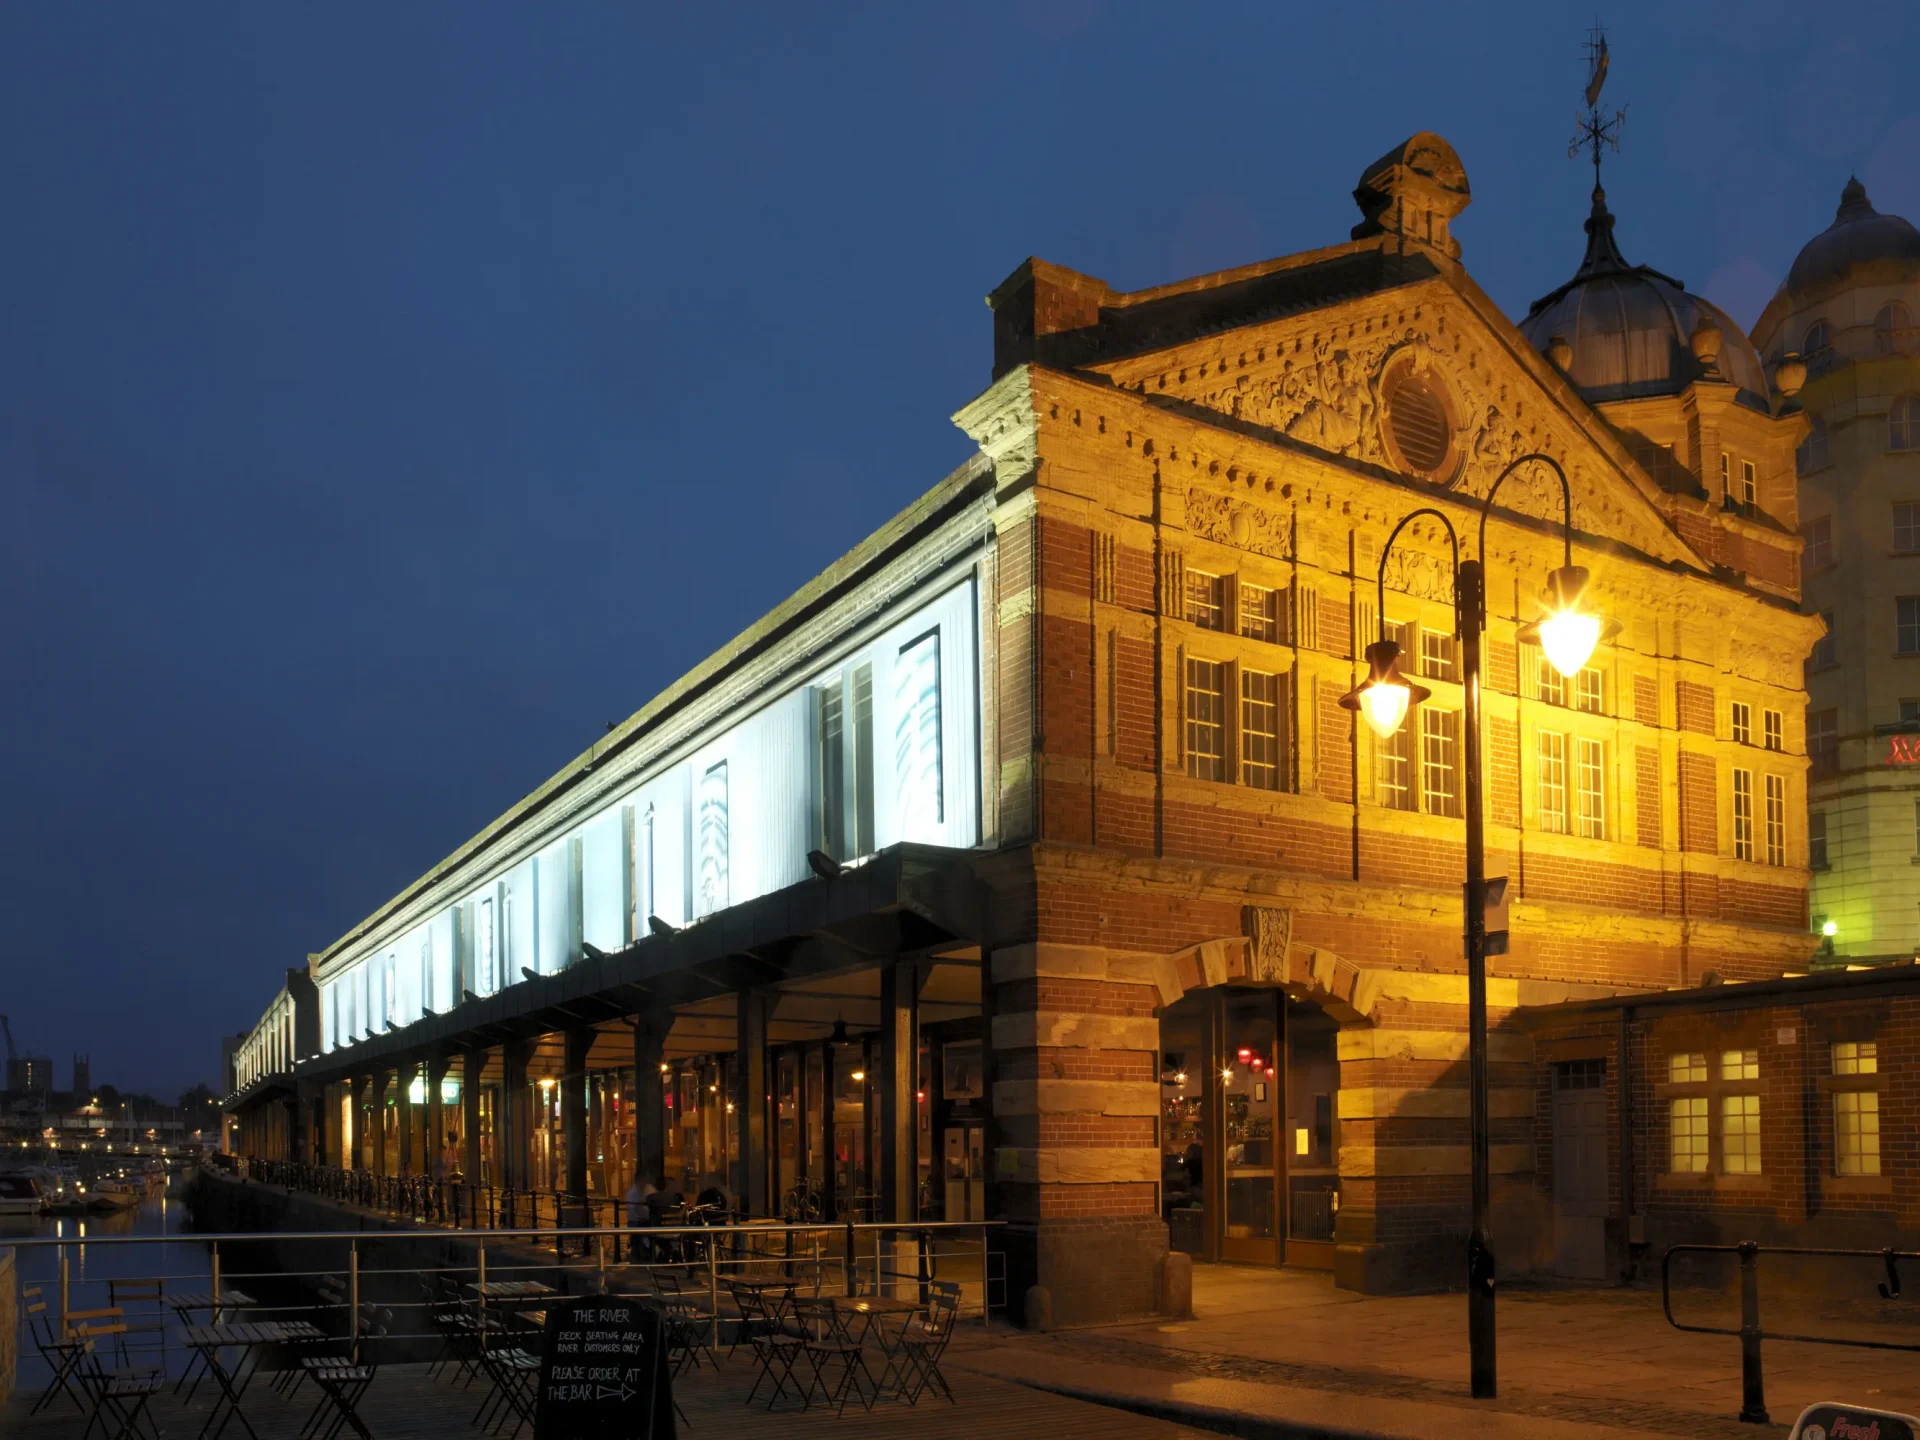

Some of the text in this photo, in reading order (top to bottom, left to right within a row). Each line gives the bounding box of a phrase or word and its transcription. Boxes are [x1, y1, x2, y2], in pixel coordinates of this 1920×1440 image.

[573, 1308, 630, 1323] THE RIVER
[558, 1331, 644, 1343] DECK SEATING AREA
[557, 1343, 640, 1355] RIVER CUSTOMERS ONLY
[551, 1365, 641, 1382] PLEASE ORDER AT
[547, 1384, 593, 1402] THE BAR
[1830, 1416, 1880, 1440] Fresh
